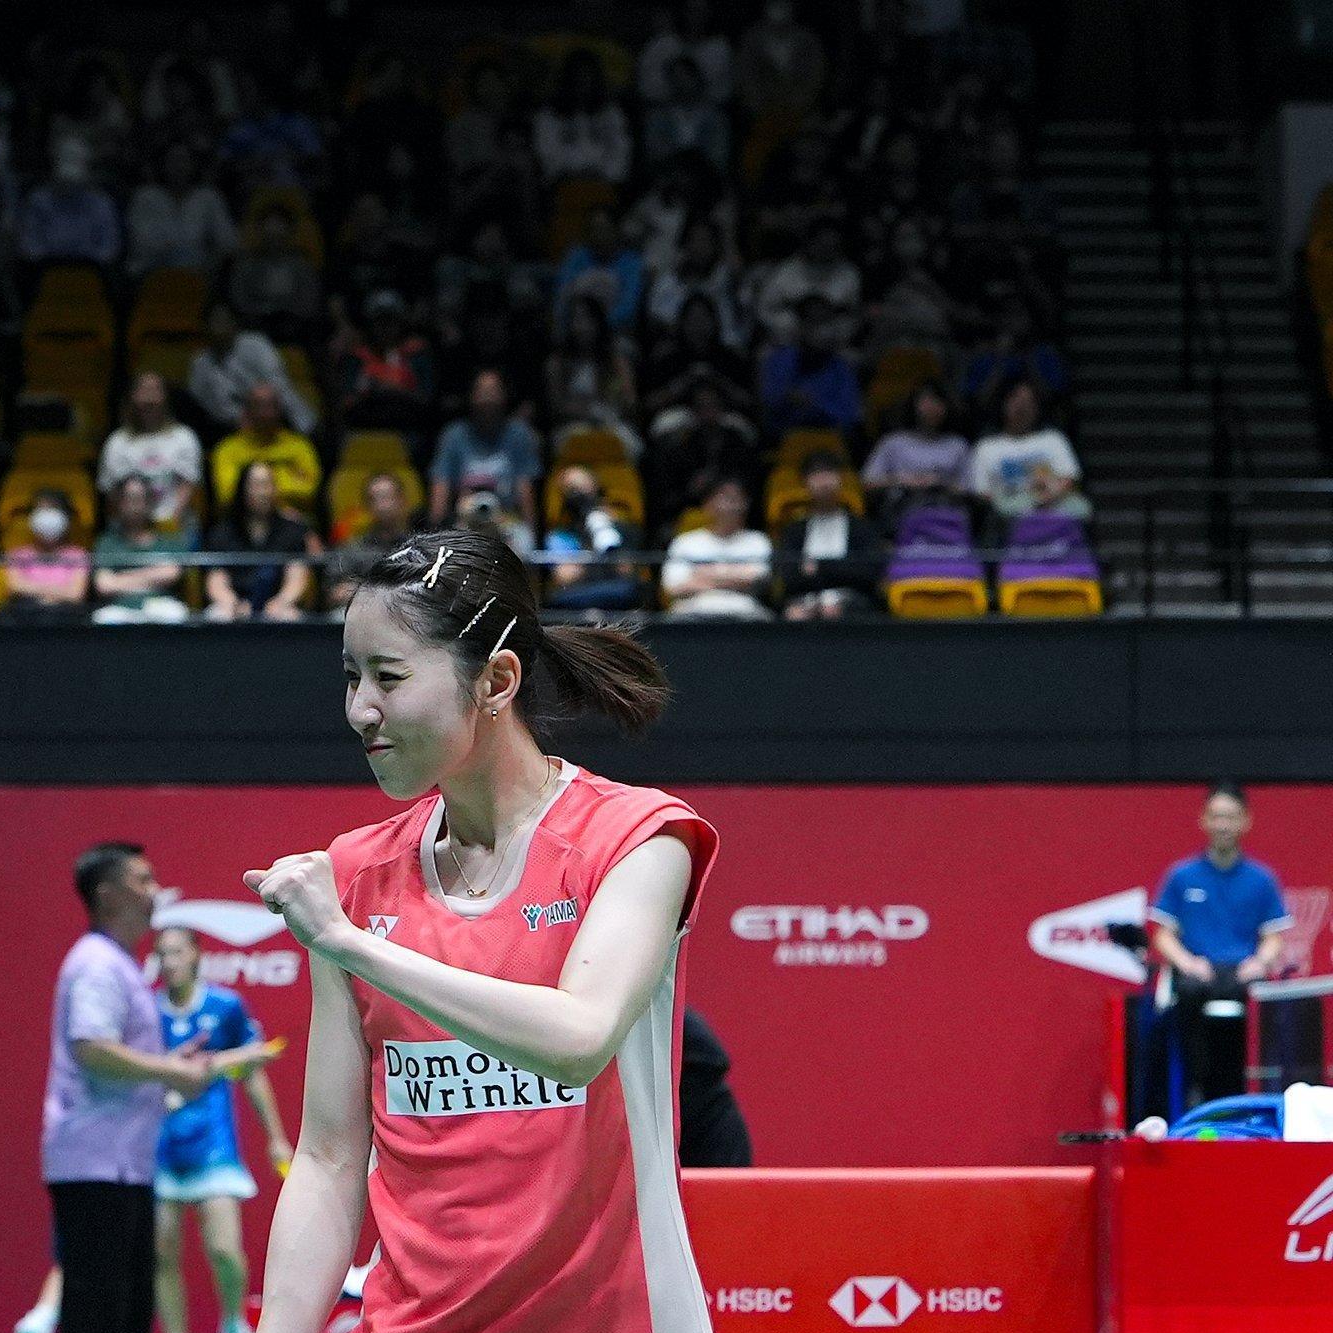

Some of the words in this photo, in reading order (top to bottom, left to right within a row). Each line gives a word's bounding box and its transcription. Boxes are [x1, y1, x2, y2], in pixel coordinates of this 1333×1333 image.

[731, 905, 930, 941] ETIHAD
[404, 1073, 575, 1113] Wrinkle
[716, 1286, 794, 1313] HSBC
[927, 1286, 1004, 1313] HSBC
